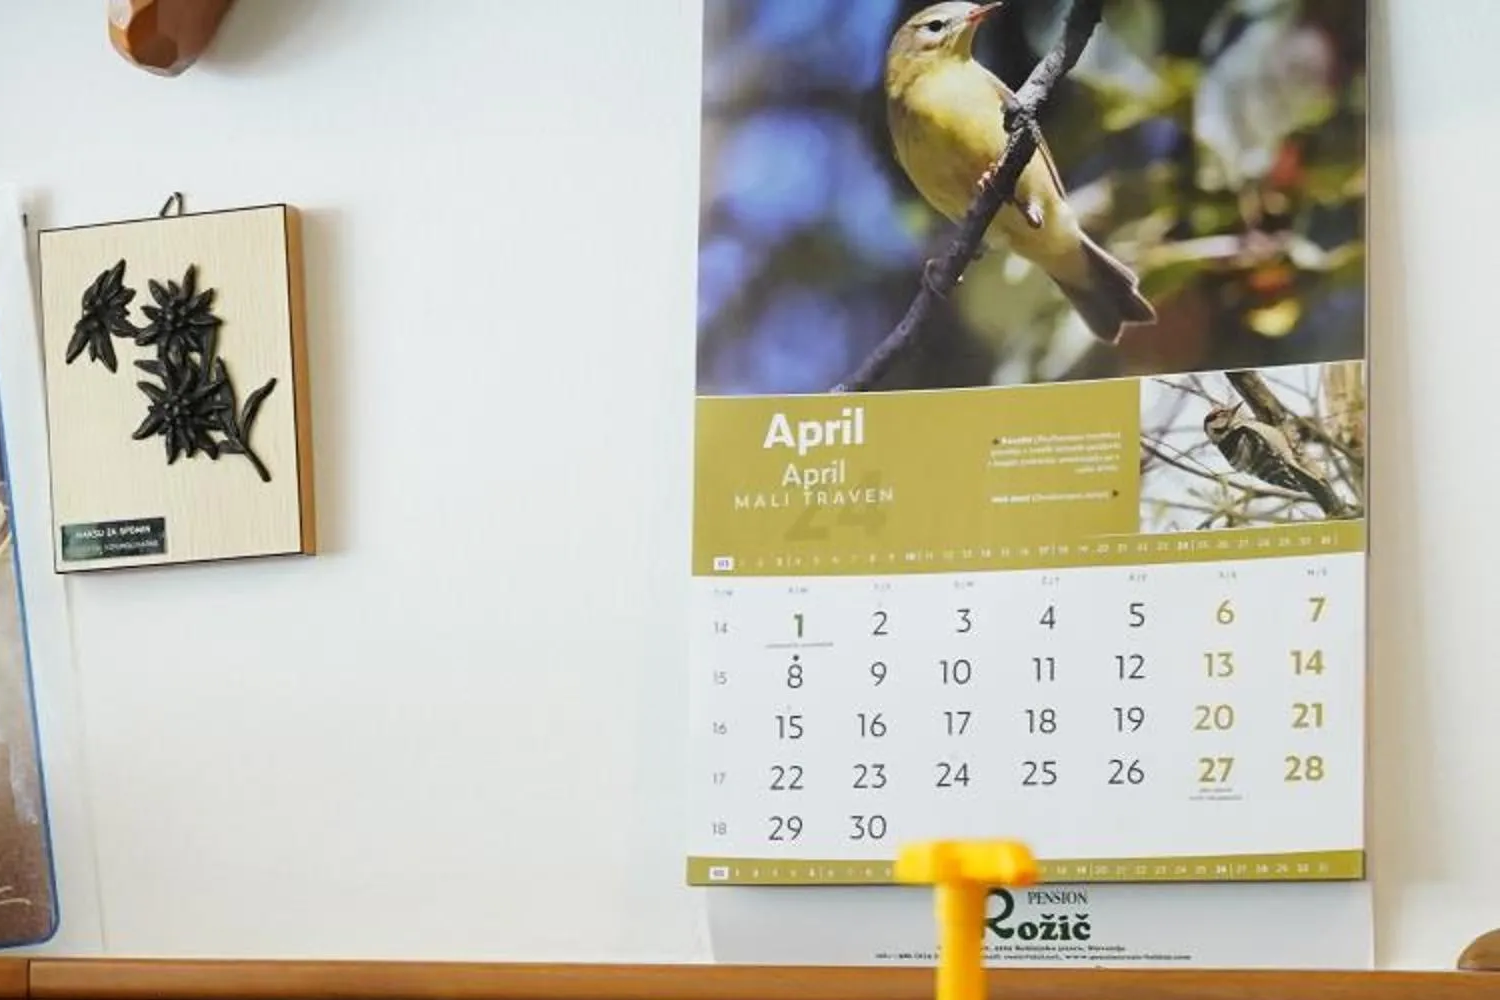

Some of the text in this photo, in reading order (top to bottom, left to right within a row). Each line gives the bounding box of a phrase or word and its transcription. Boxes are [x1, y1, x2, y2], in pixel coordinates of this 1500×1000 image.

[763, 407, 864, 456] April
[782, 459, 845, 489] April
[735, 487, 893, 510] MALI TRAVEN
[715, 597, 1326, 637] 14 1 2 3 4 5 6 7
[714, 650, 1324, 688] 15 8 9 10 11 12 13 14
[713, 703, 1323, 739] 16 15 16 17 18 19 20 21
[713, 756, 1324, 790] 17 22 23 24 25 26 27 28
[713, 815, 886, 840] 18 29 30
[983, 887, 1092, 941] Rožič
[1027, 890, 1088, 905] PENSION
